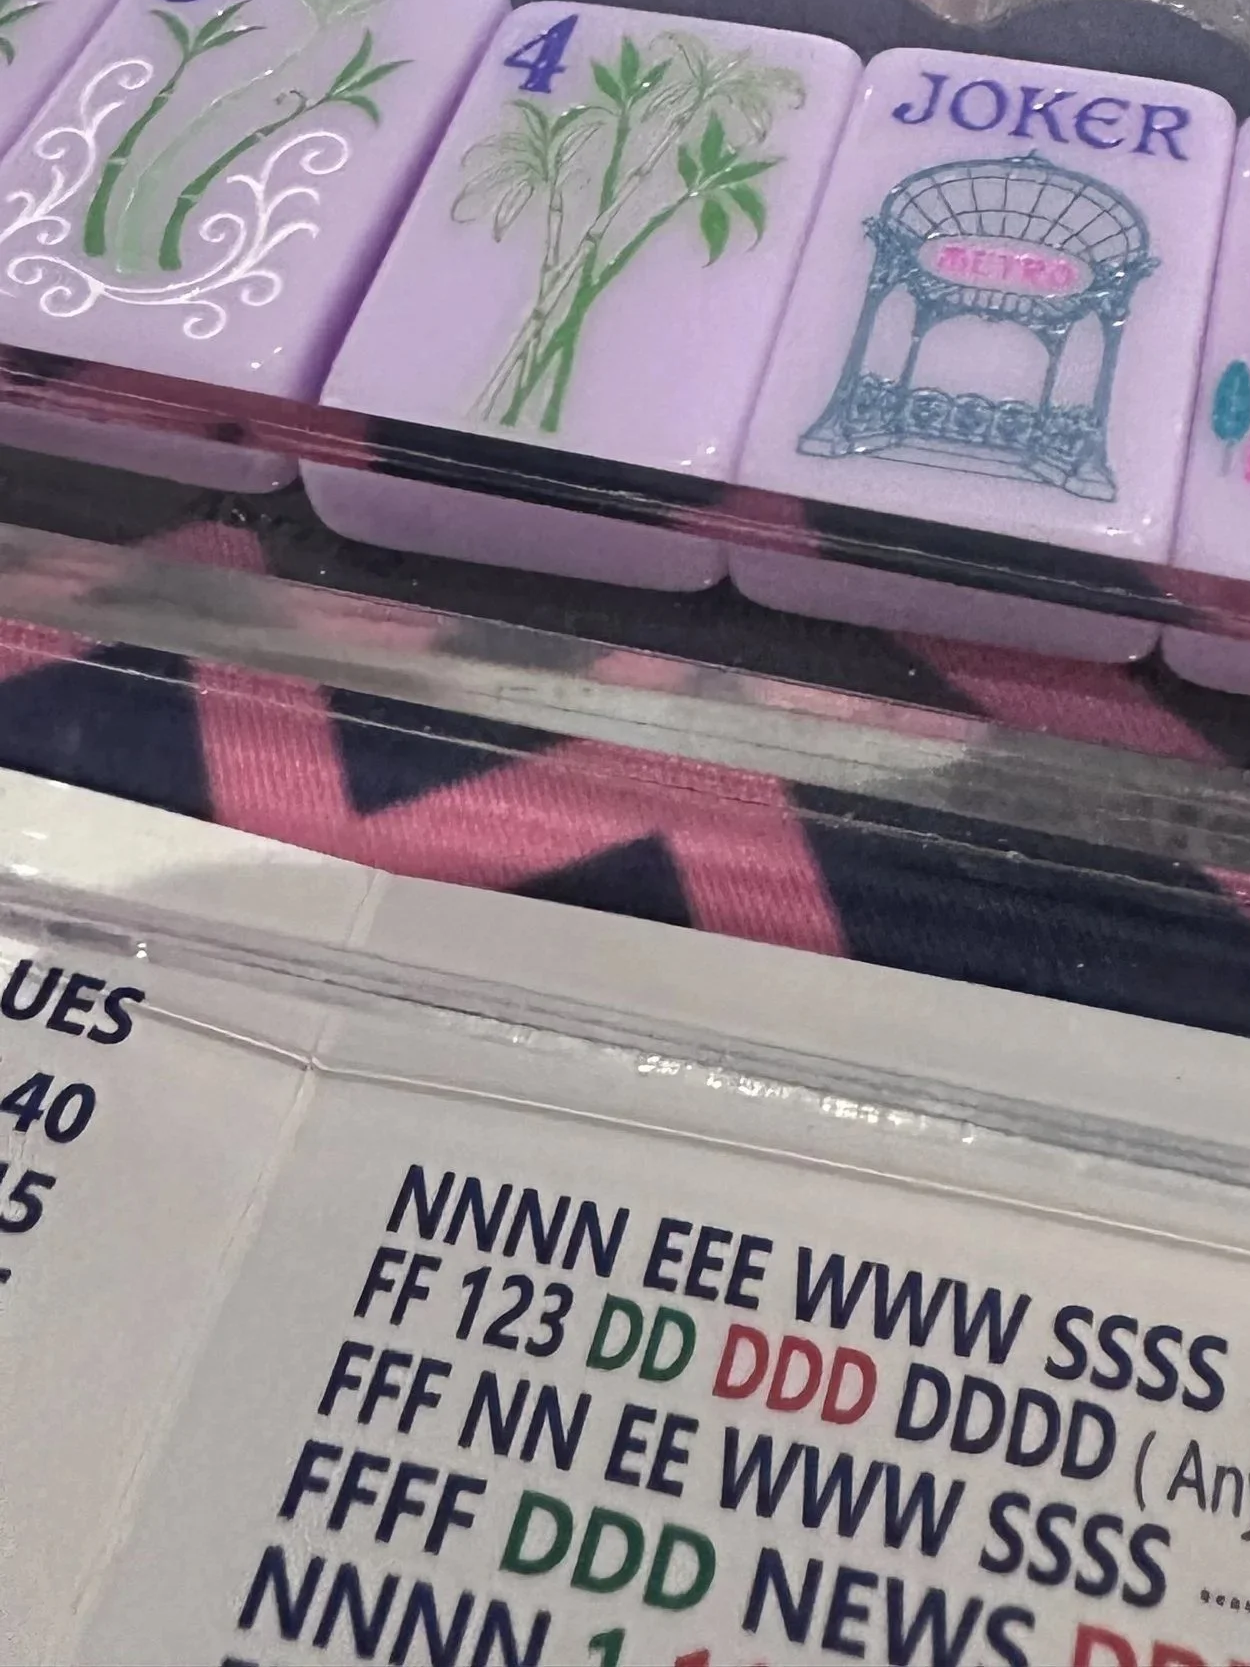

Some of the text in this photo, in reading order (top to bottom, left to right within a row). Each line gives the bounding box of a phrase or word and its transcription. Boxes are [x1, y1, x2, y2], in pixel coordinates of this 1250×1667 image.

[503, 14, 579, 94] 4
[892, 72, 1191, 161] JOKER
[938, 245, 1079, 291] METRO
[354, 1246, 442, 1326] FF
[456, 1266, 574, 1358] 123
[586, 1293, 696, 1383] DD
[712, 1324, 877, 1425] DDD
[895, 1362, 1116, 1481] DDDD
[386, 1164, 630, 1279] NNNN
[643, 1217, 773, 1311] EEE
[795, 1246, 1032, 1365] WWW
[1044, 1305, 1229, 1413] SSSS
[277, 1439, 1035, 1667] FFFF DDD NEWS
[318, 1340, 1171, 1609] FFF NN EE WWW SSSS
[237, 1545, 551, 1667] NNNN
